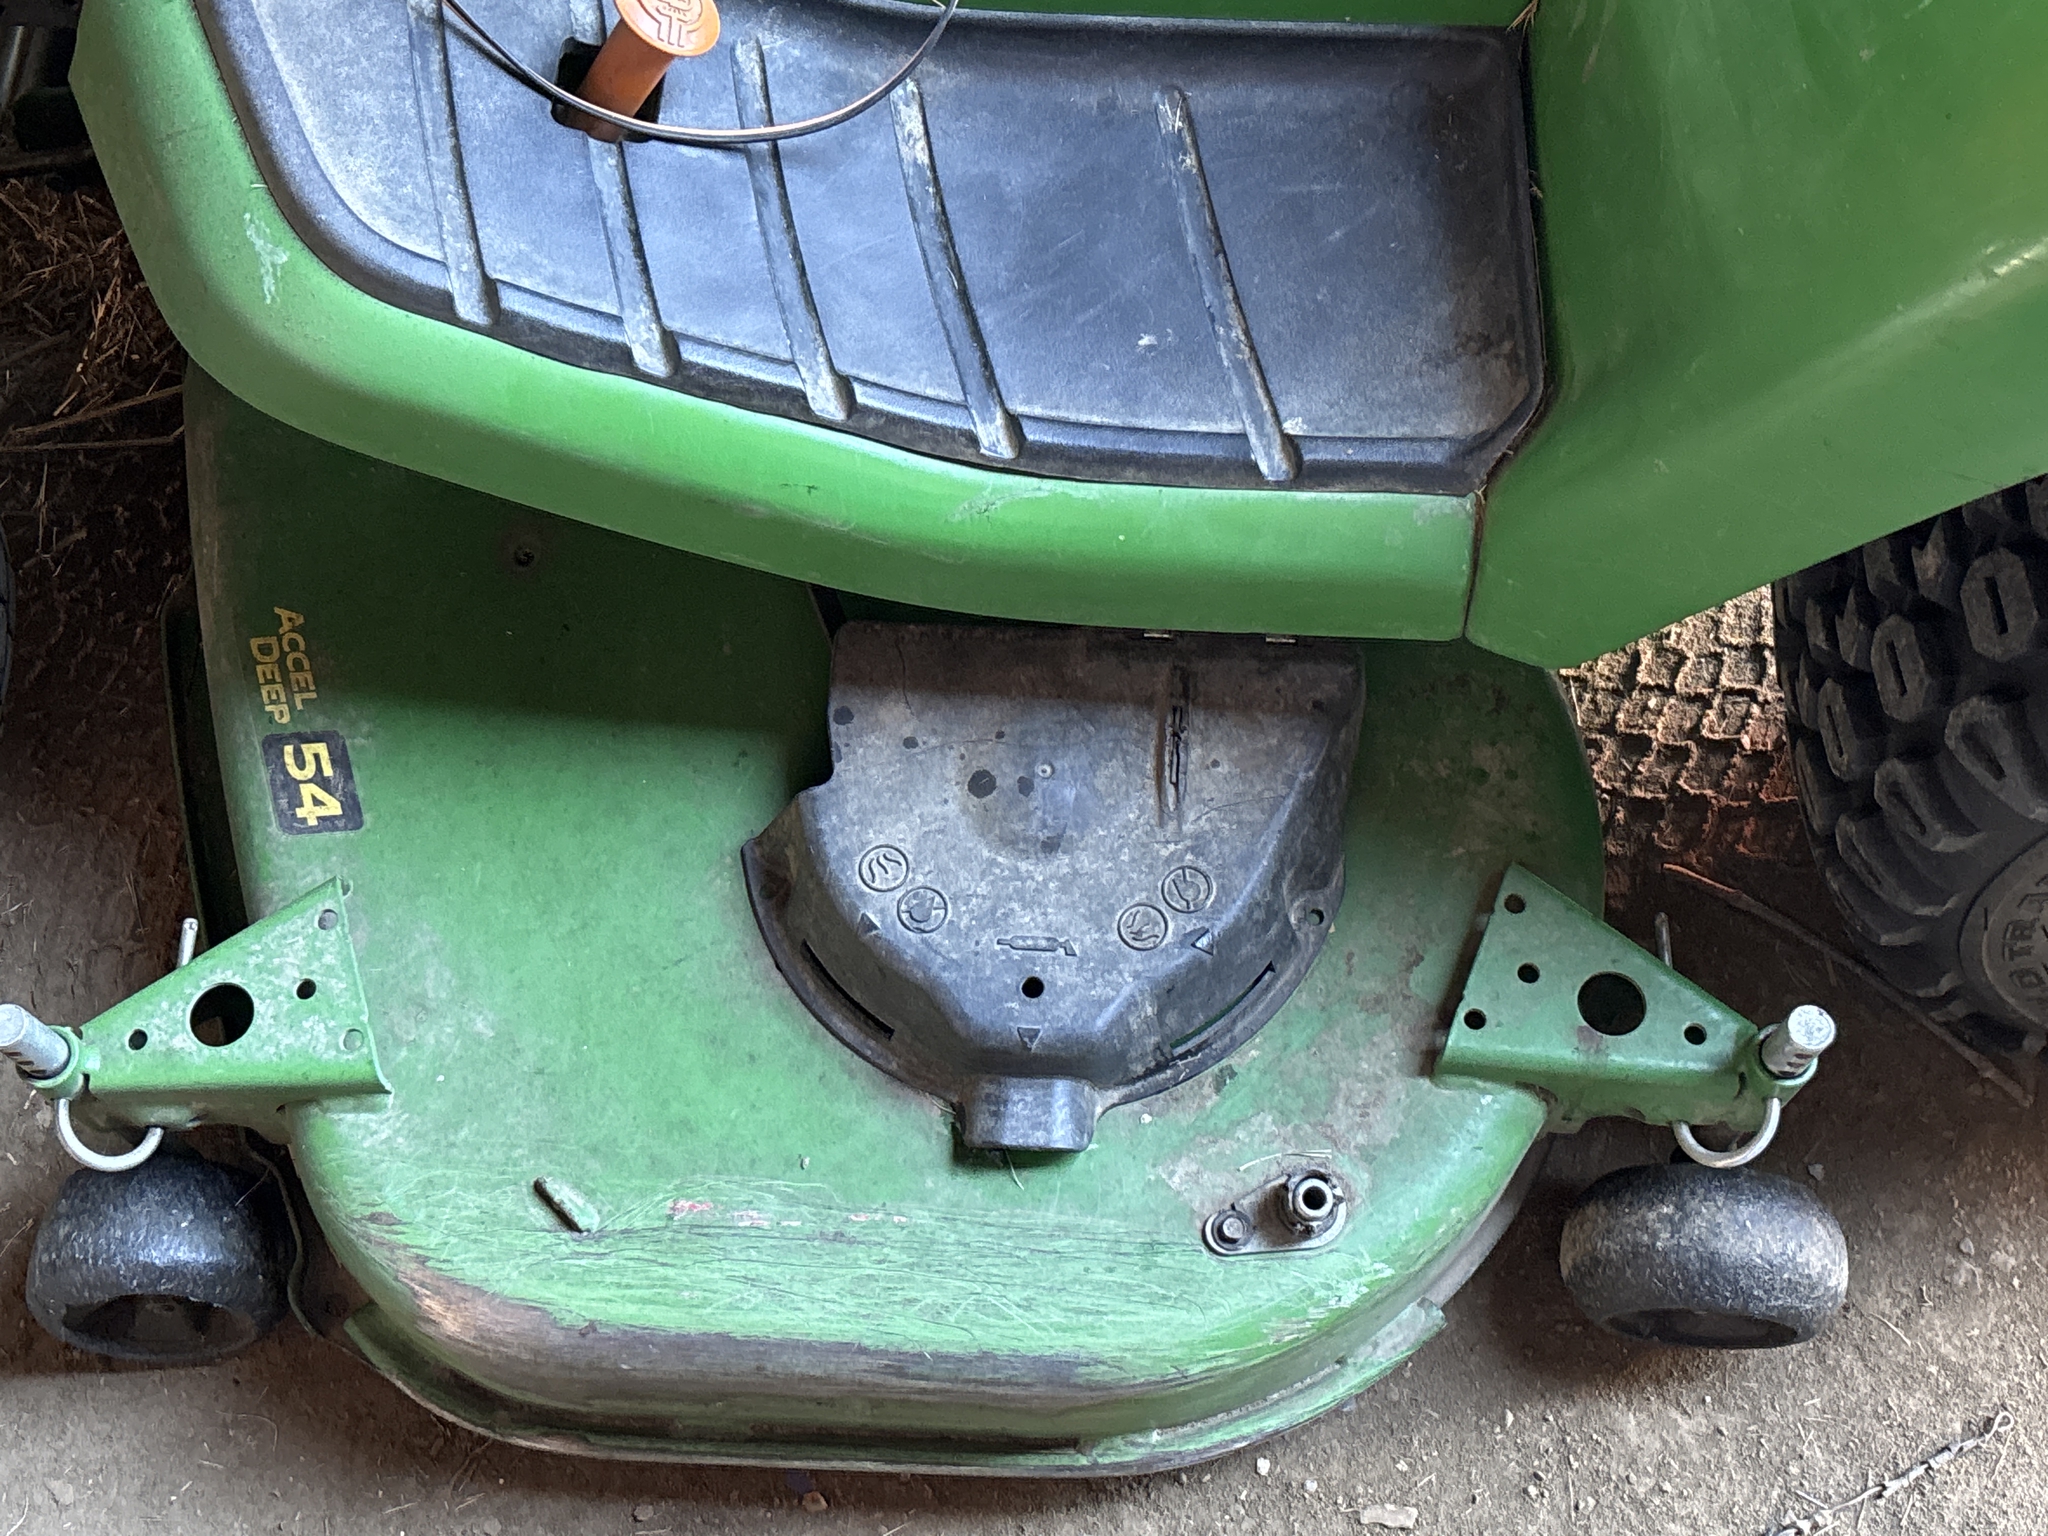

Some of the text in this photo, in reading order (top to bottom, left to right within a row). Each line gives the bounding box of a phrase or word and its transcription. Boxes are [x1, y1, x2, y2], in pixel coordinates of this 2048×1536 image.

[250, 635, 291, 725] DEEP
[273, 606, 318, 711] ACCEL
[283, 742, 343, 827] 54
